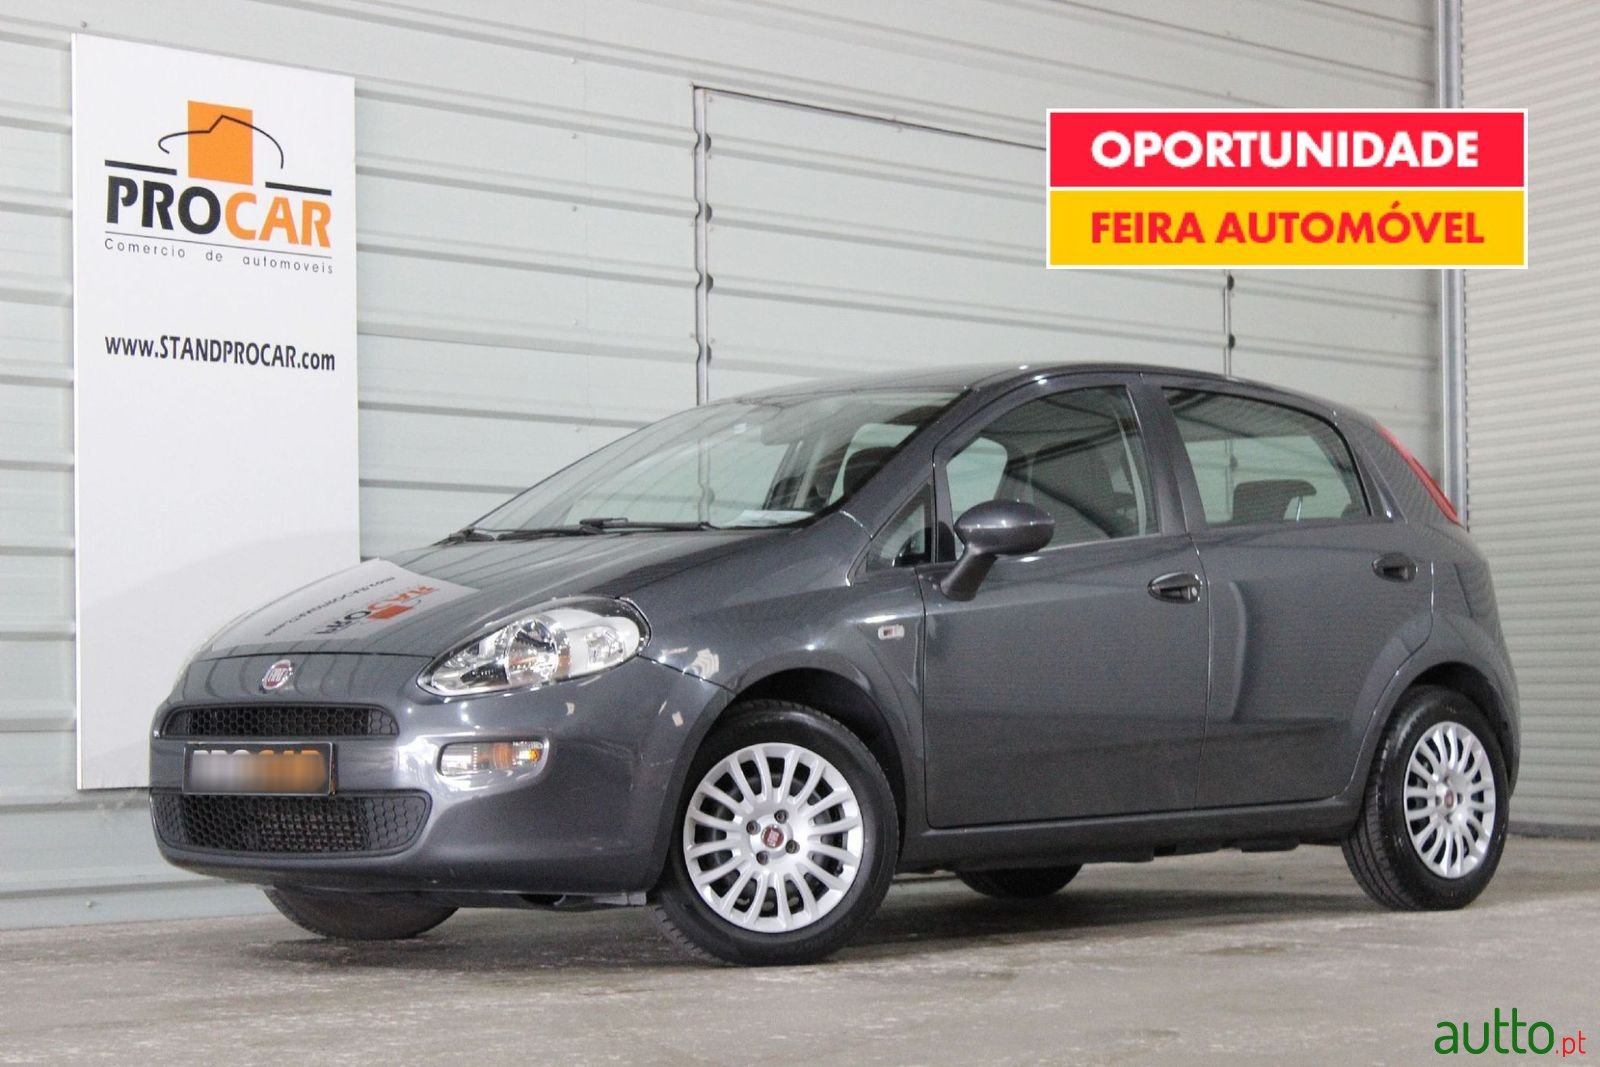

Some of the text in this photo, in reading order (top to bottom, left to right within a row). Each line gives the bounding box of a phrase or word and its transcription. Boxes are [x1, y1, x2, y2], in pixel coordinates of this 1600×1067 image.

[105, 175, 332, 249] PROCAR
[104, 237, 334, 275] Comercio de automoveis
[104, 334, 336, 371] www.STANDPROCAR.com
